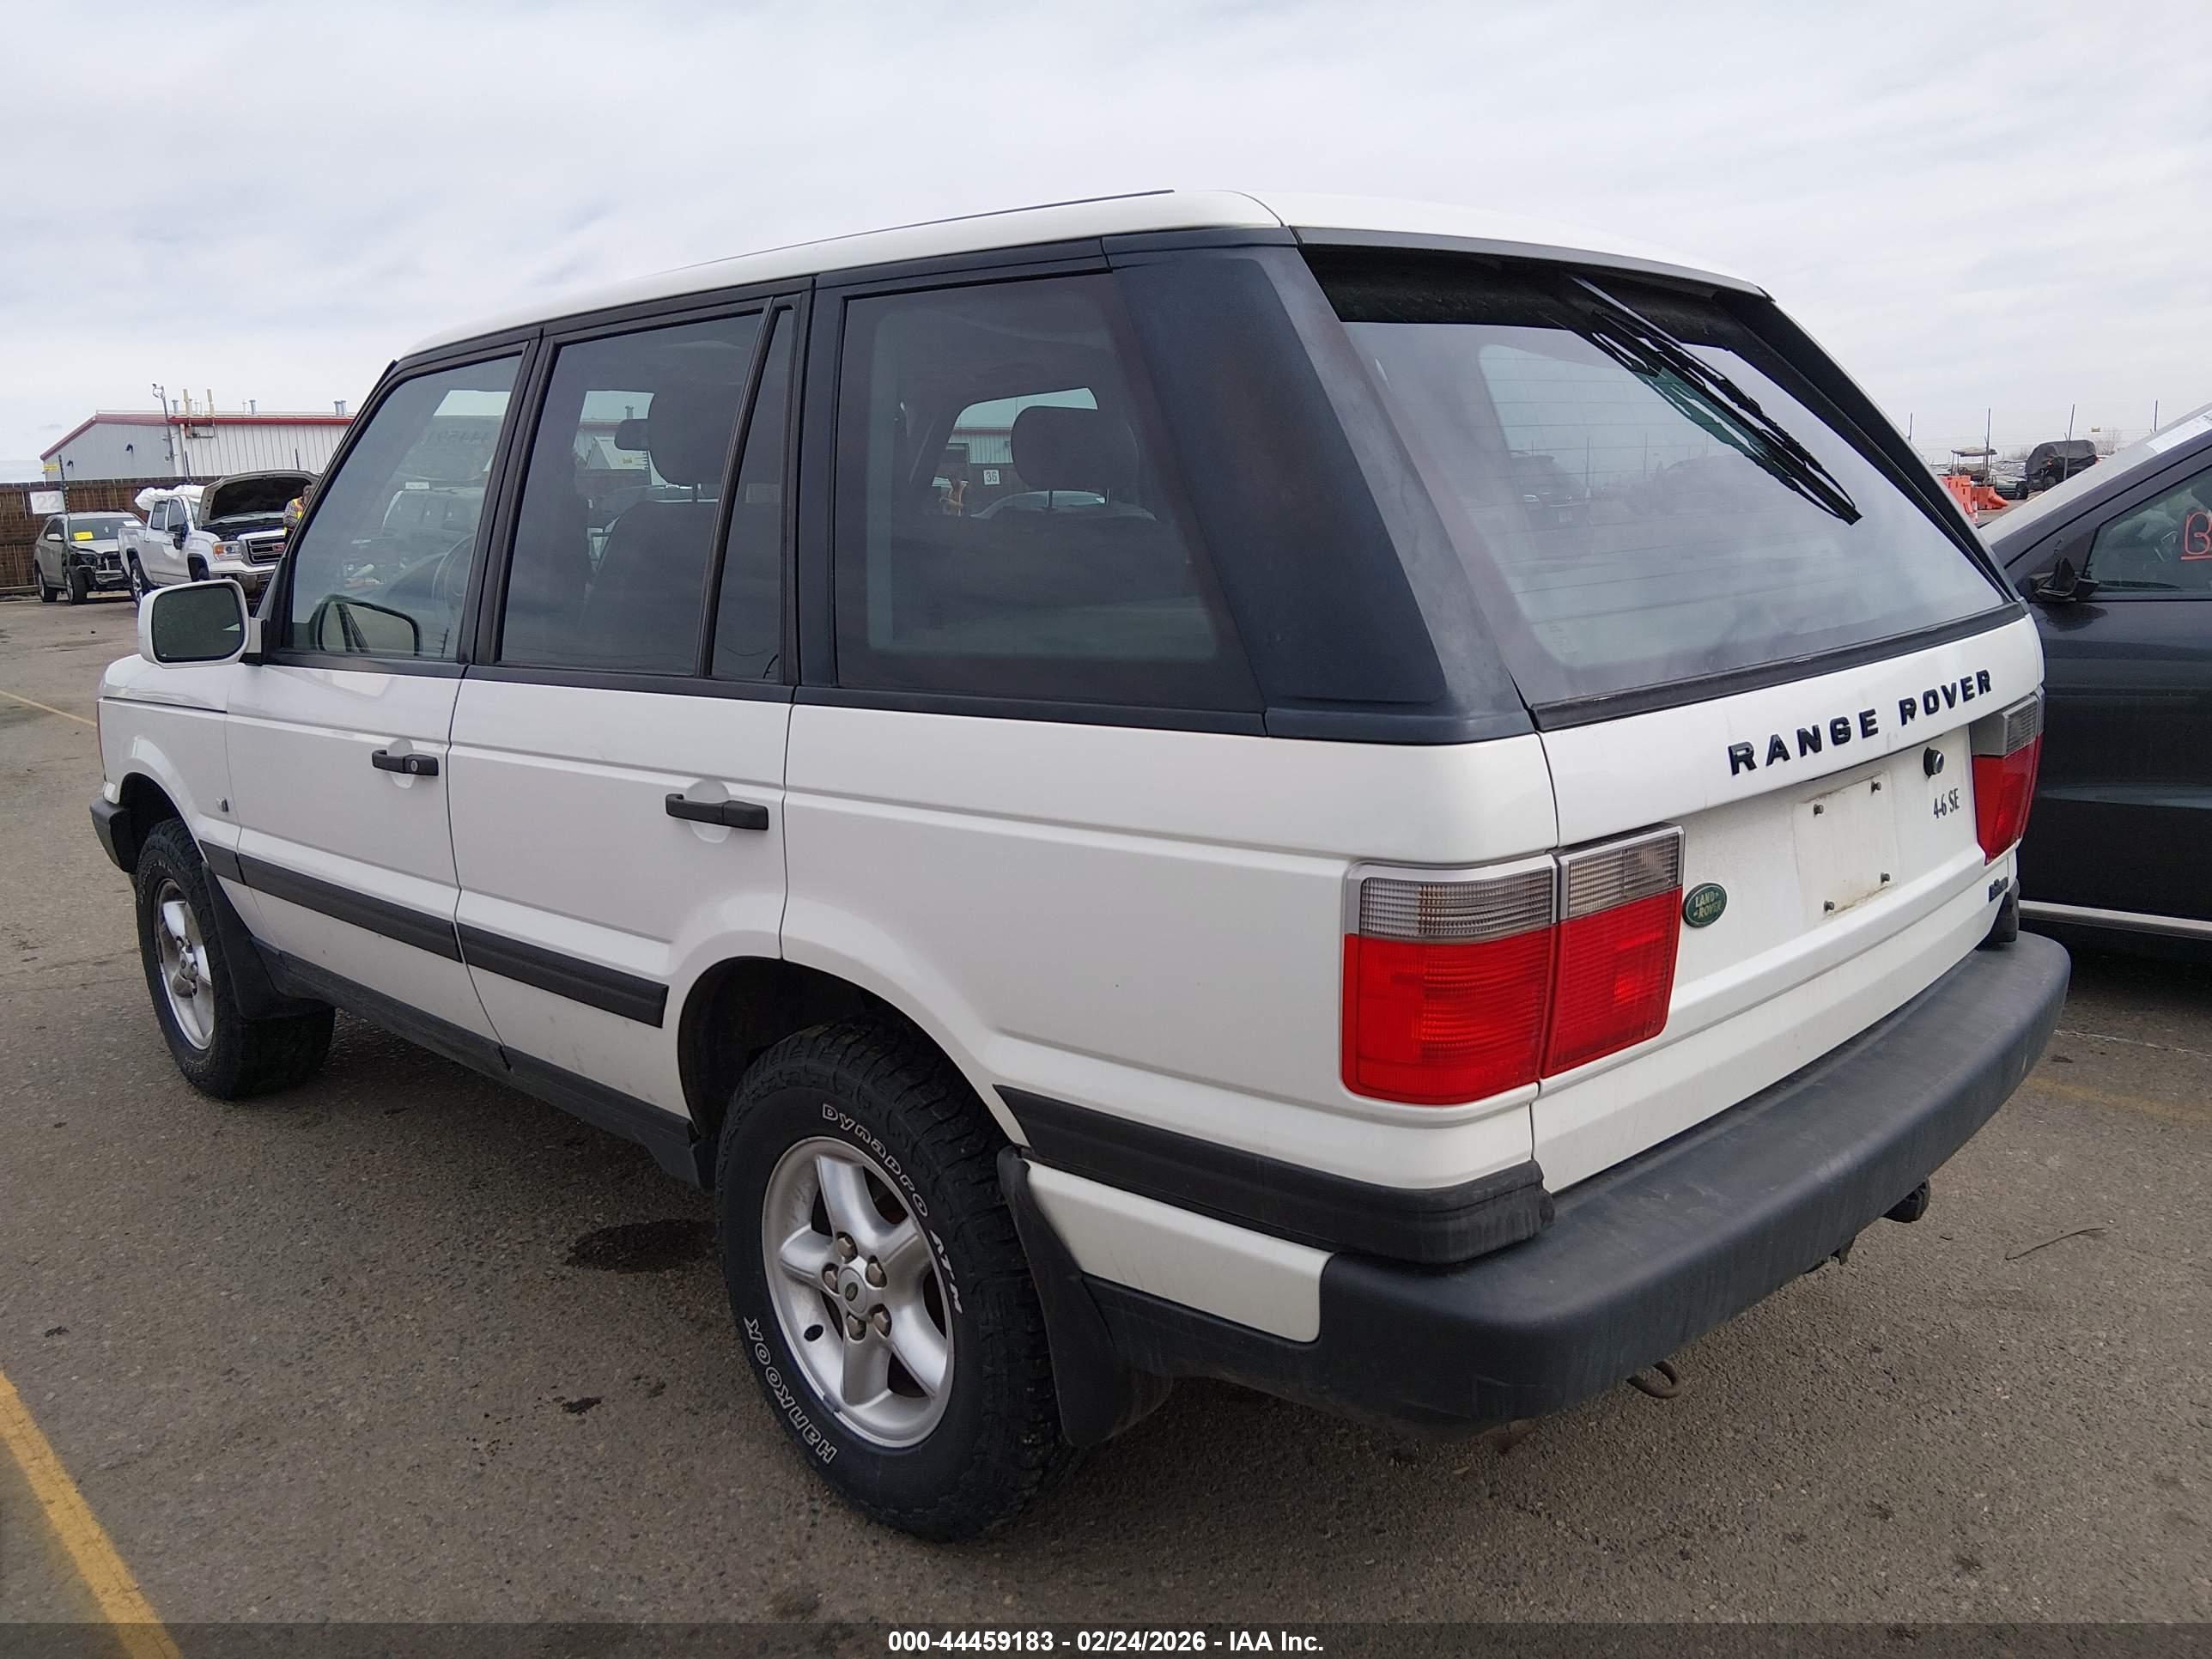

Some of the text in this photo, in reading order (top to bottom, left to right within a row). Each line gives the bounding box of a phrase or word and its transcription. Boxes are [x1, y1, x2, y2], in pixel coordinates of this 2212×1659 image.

[986, 471, 998, 482] 36
[36, 494, 59, 510] 22
[1727, 669, 1992, 776] RANGE ROVER
[1948, 787, 1960, 813] SE
[1695, 890, 1716, 908] LAND
[1698, 900, 1722, 919] ROVER
